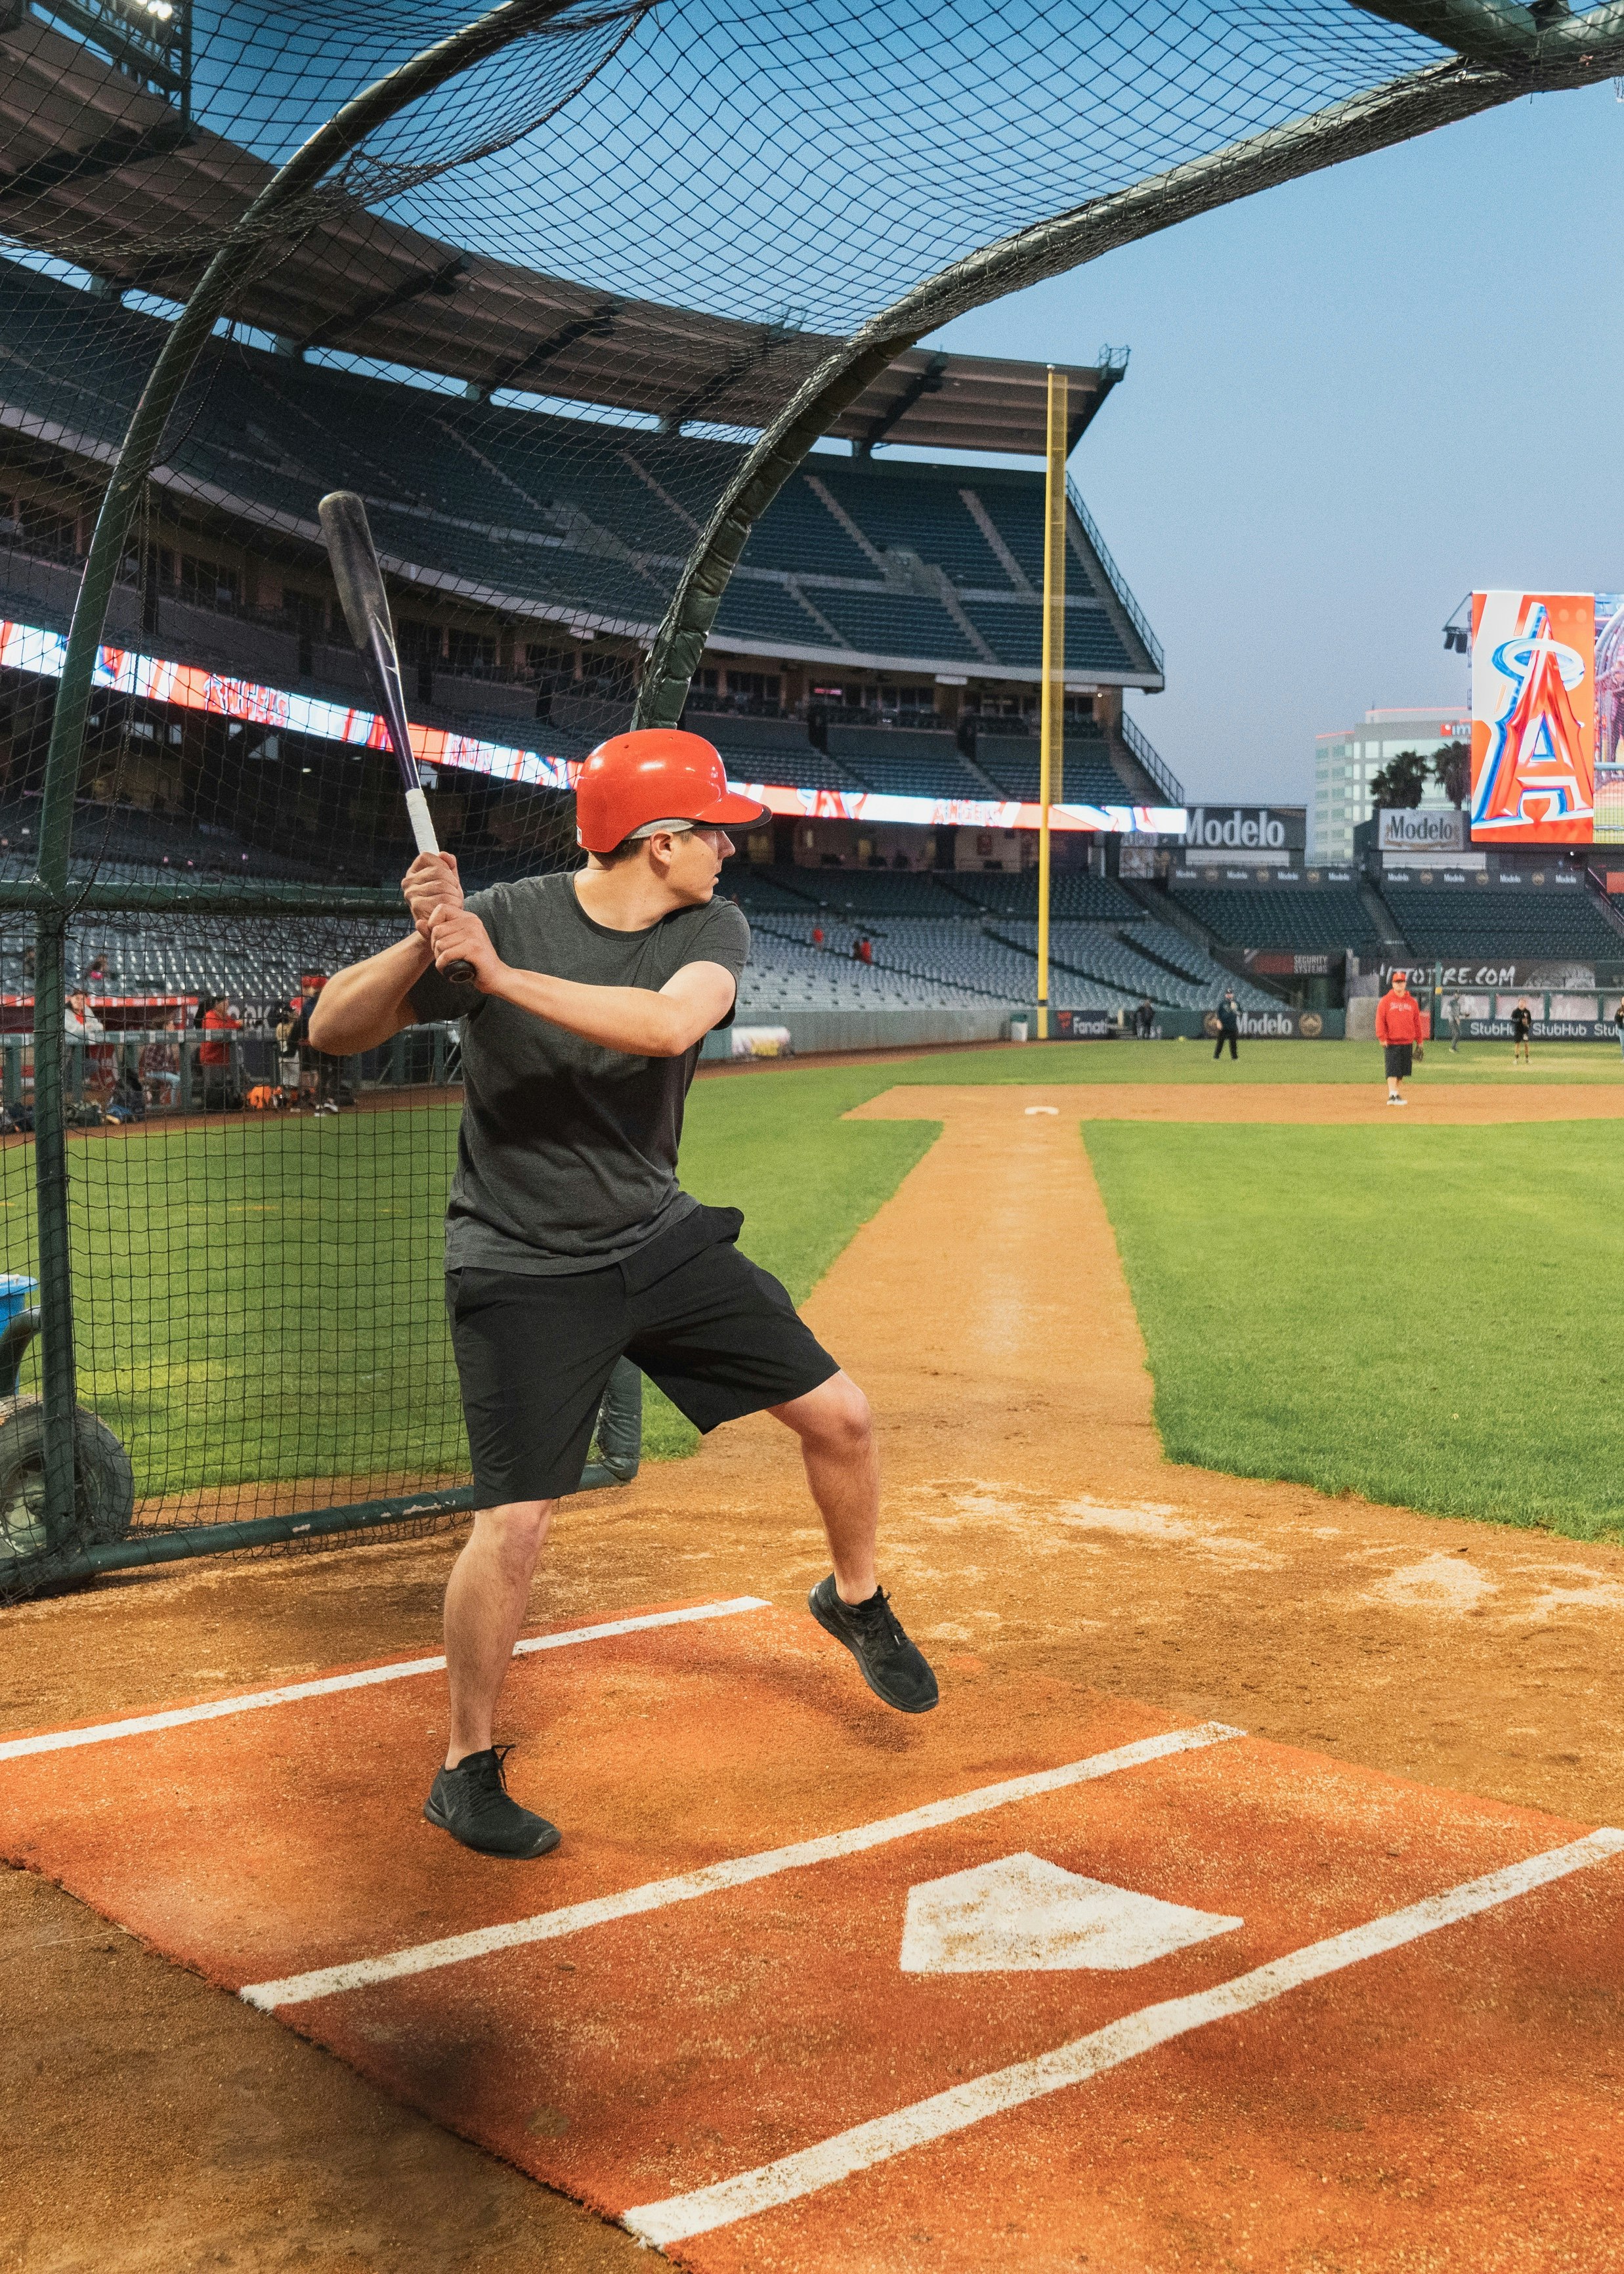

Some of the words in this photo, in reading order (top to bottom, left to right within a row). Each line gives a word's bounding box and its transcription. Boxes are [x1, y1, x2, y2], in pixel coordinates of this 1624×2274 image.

[1178, 808, 1285, 847] Modelo
[1390, 815, 1452, 840] Modelo
[1500, 874, 1521, 884] Modelo
[1555, 874, 1577, 884] Modelo
[1294, 955, 1328, 964] SECURITY
[1294, 964, 1328, 974] SYSTEMS
[1236, 1012, 1293, 1035] Modelo
[1532, 1022, 1587, 1036] StubHub
